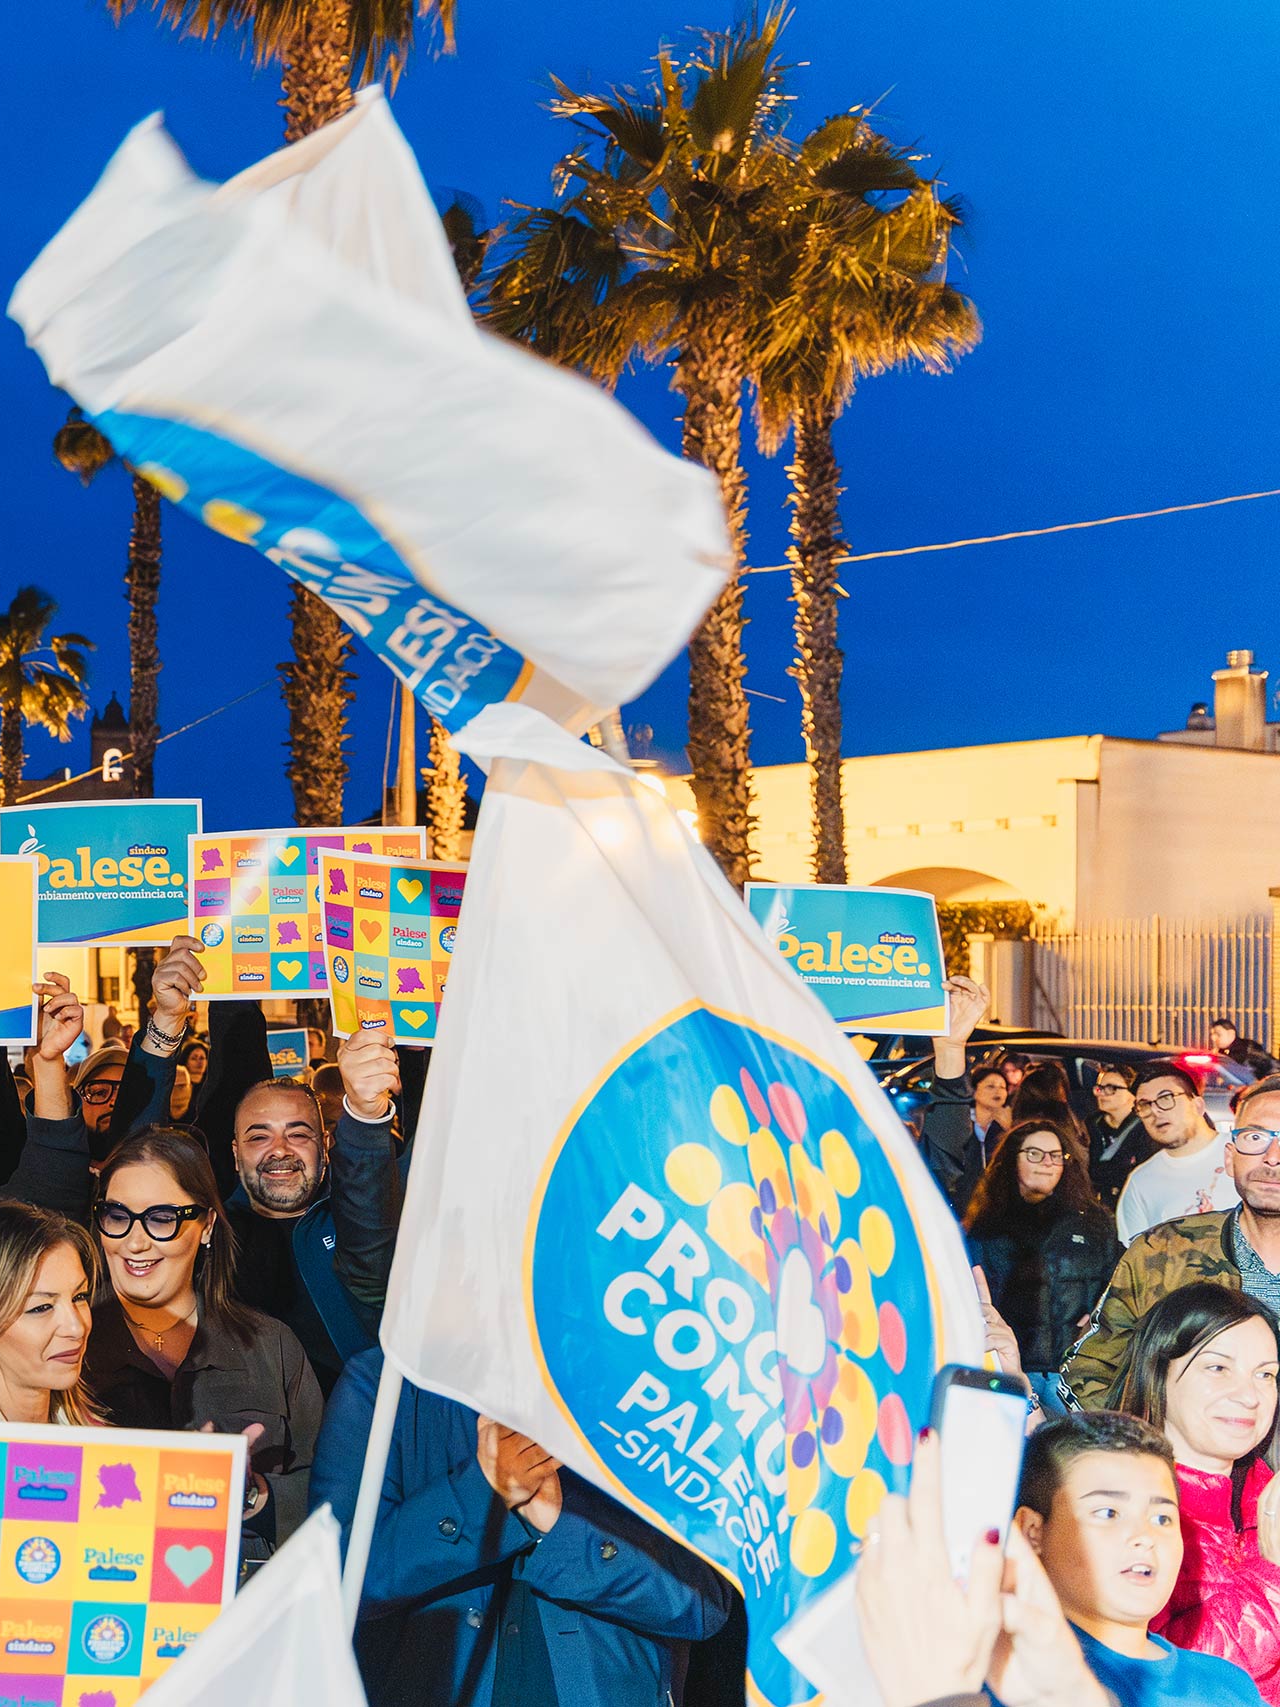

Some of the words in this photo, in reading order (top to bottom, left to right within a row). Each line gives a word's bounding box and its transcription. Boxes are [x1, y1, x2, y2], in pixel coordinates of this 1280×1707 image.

[129, 846, 166, 855] sindaco
[357, 877, 387, 890] Palese
[96, 891, 118, 899] vero
[120, 889, 166, 899] comincia
[272, 887, 305, 897] Palese
[360, 889, 382, 898] sindaco
[393, 927, 427, 939] Palese
[880, 934, 915, 944] sindaco
[843, 977, 866, 985] vero
[867, 977, 913, 988] comincia
[914, 980, 930, 988] ora
[596, 1182, 786, 1410] PROG
[616, 1371, 780, 1587] PALESE
[84, 1548, 144, 1566] Palese
